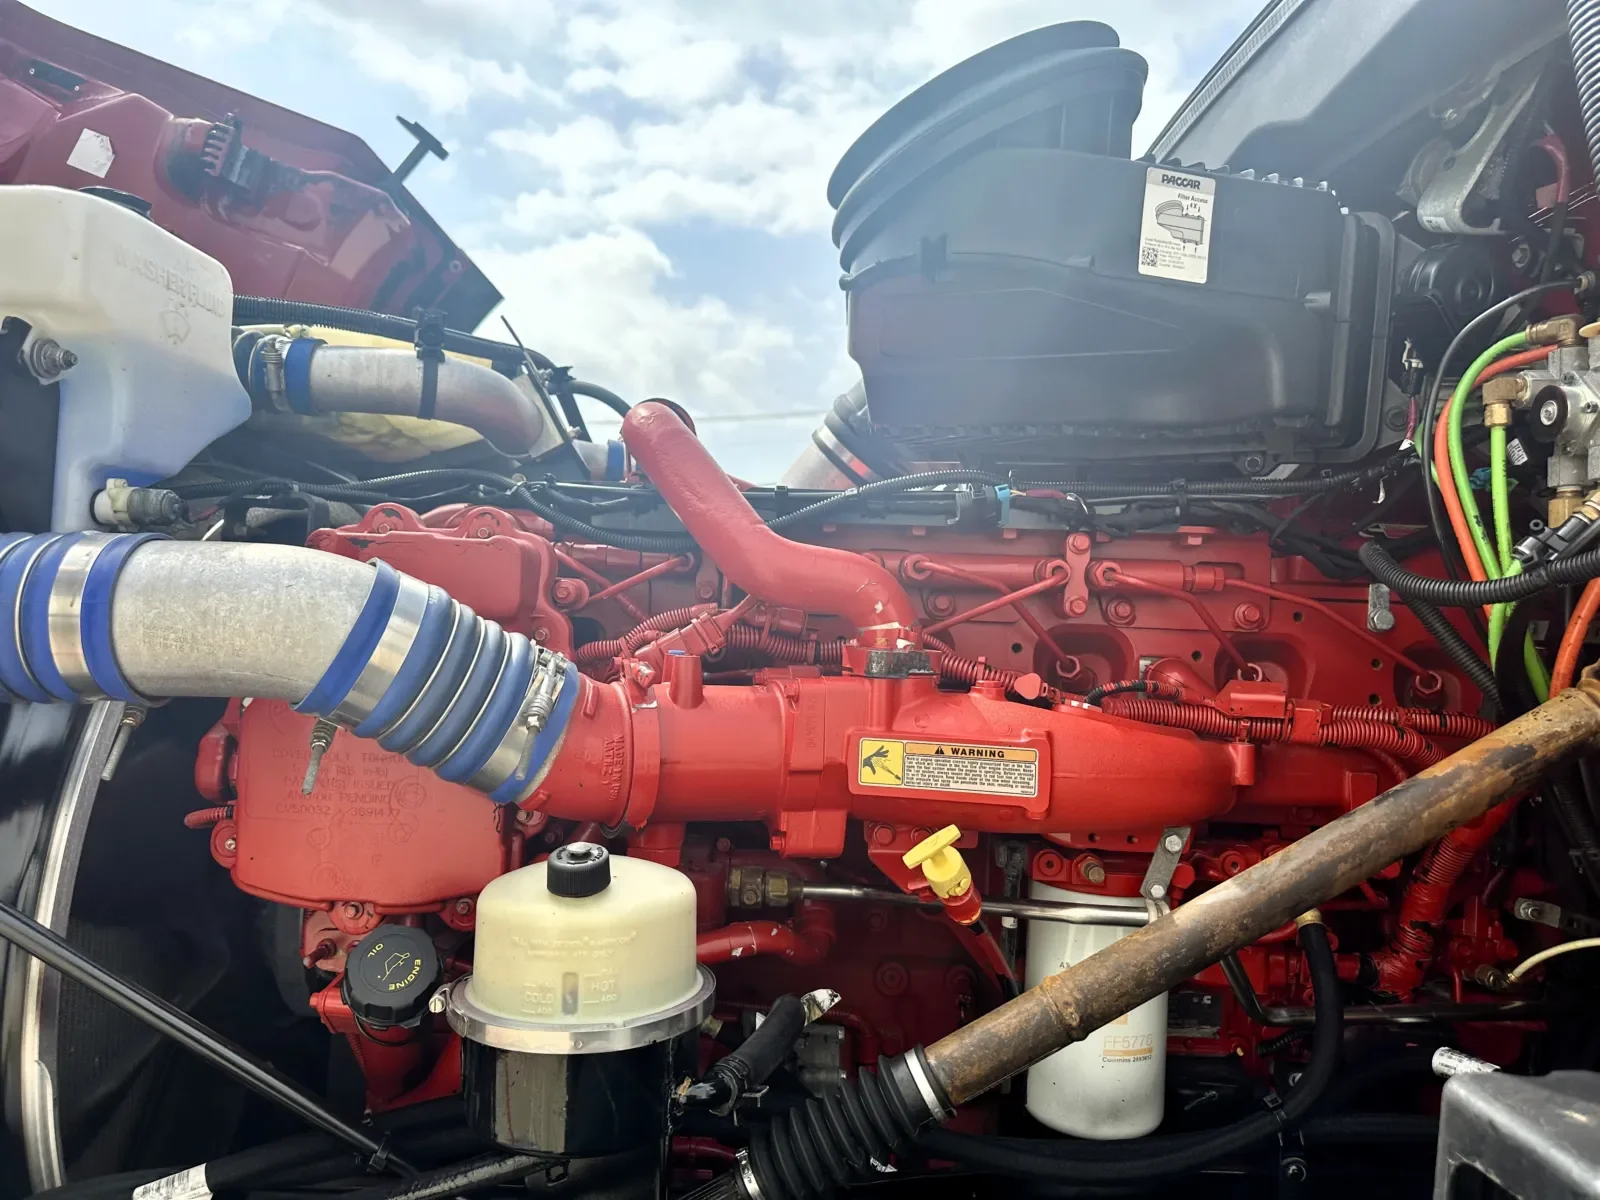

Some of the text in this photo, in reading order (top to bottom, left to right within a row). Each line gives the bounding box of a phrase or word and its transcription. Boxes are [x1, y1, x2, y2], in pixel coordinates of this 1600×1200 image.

[1161, 174, 1200, 190] PACCAR
[1178, 193, 1208, 204] Filter Access
[614, 735, 624, 766] MADE
[951, 747, 1005, 758] WARNING
[368, 943, 384, 958] OIL
[388, 959, 422, 990] ENGINE
[591, 980, 616, 992] HOT
[524, 990, 554, 1004] COLD
[601, 993, 618, 1002] ADD
[1104, 1034, 1152, 1048] FF5776
